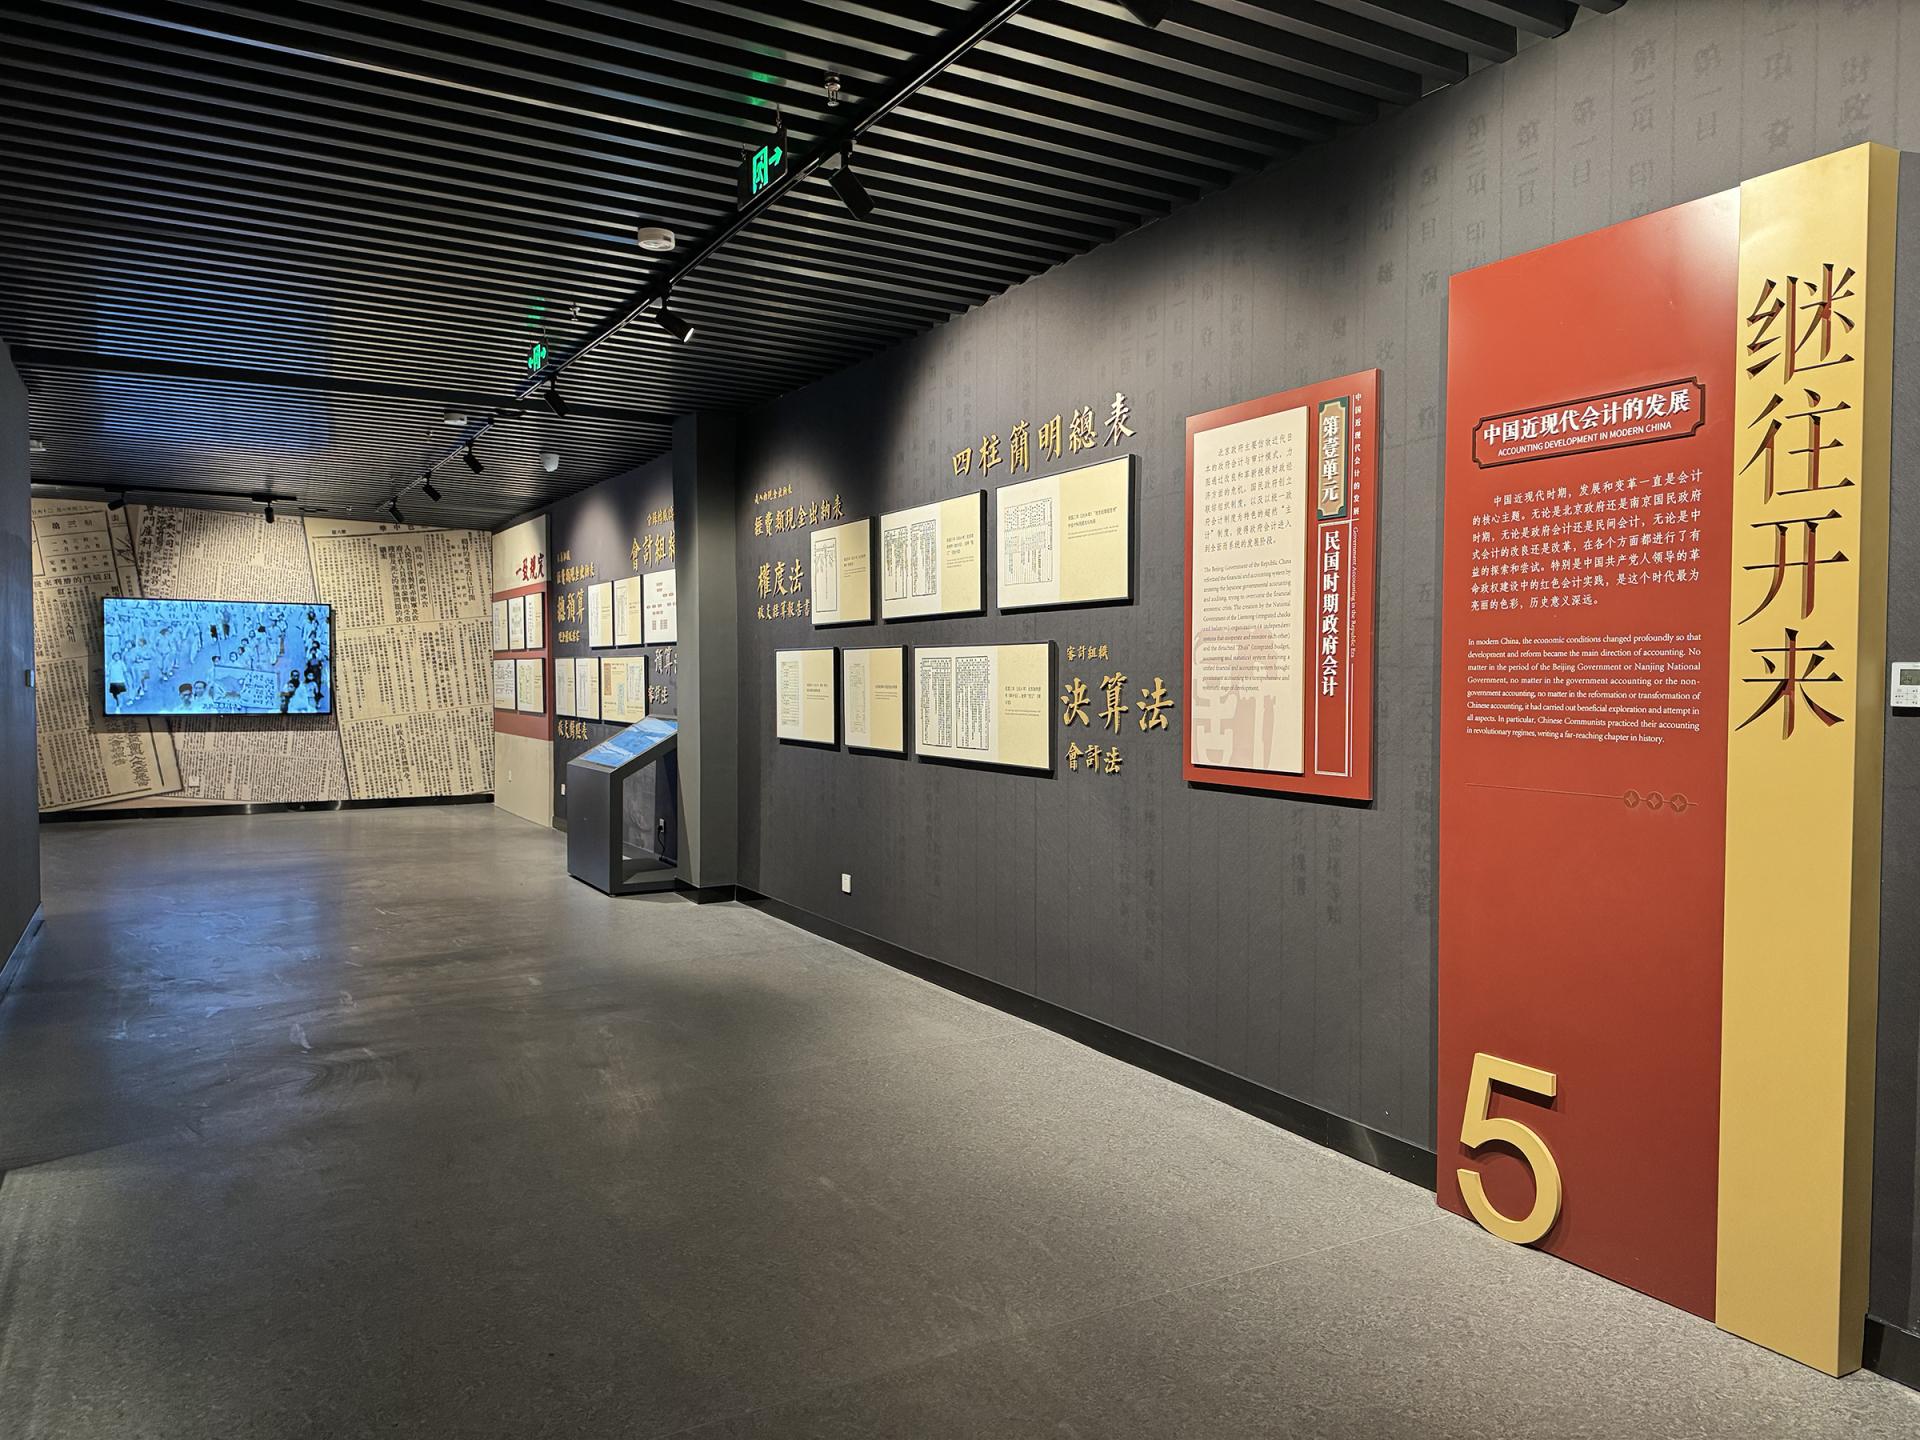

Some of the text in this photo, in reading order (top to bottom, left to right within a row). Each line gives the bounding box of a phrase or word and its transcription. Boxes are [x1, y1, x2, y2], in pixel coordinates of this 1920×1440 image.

[1483, 388, 1691, 446] 中国近现代会计的发展
[952, 392, 1136, 477] 四柱簡明總表
[1498, 421, 1672, 457] ACCOUNTING DEVELOPMENT IN MODERN CHINA
[1322, 415, 1340, 503] 第壹单元
[1735, 263, 1857, 741] 继往开来
[1322, 530, 1340, 697] 民国时期政府会计
[1467, 650, 1506, 660] development
[1506, 649, 1519, 658] and
[1520, 649, 1542, 658] reform
[1542, 649, 1568, 658] became
[1569, 648, 1580, 657] the
[1581, 648, 1599, 657] main
[1599, 648, 1632, 657] direction
[1475, 637, 1500, 646] modern
[1522, 636, 1533, 645] the
[1533, 635, 1565, 645] economic
[1565, 634, 1602, 644] conditions
[1602, 633, 1632, 645] changed
[1633, 632, 1675, 645] profoundly
[1686, 632, 1702, 641] that
[1496, 663, 1507, 671] the
[1508, 662, 1530, 673] period
[1539, 662, 1551, 671] the
[1552, 662, 1576, 673] Beijing
[1576, 662, 1622, 671] Government
[1634, 662, 1665, 673] Nanjing
[1666, 661, 1701, 671] National
[1552, 675, 1565, 684] the
[1565, 678, 1609, 687] government
[1609, 676, 1652, 688] accounting
[1665, 676, 1678, 685] the
[1060, 671, 1175, 735] 決算法
[1466, 690, 1502, 698] government
[1576, 689, 1587, 698] the
[1588, 689, 1628, 699] reformation
[1637, 690, 1691, 700] transformation
[1466, 701, 1491, 709] Chinese
[1530, 702, 1542, 711] had
[1542, 703, 1565, 711] carried
[1576, 703, 1608, 713] beneficial
[1608, 704, 1647, 715] exploration
[1647, 705, 1663, 714] and
[1662, 707, 1691, 717] attempt
[1466, 713, 1474, 721] all
[1537, 715, 1563, 725] Chinese
[1563, 716, 1607, 726] Communists
[1607, 719, 1639, 729] practiced
[1640, 719, 1658, 728] their
[1658, 721, 1700, 732] accounting
[1473, 726, 1512, 737] revolutionary
[1537, 729, 1560, 740] writing
[1564, 730, 1604, 743] far-reaching
[1603, 731, 1630, 743] chapter
[1065, 742, 1123, 774] 會計法
[1457, 1052, 1562, 1243] 5
